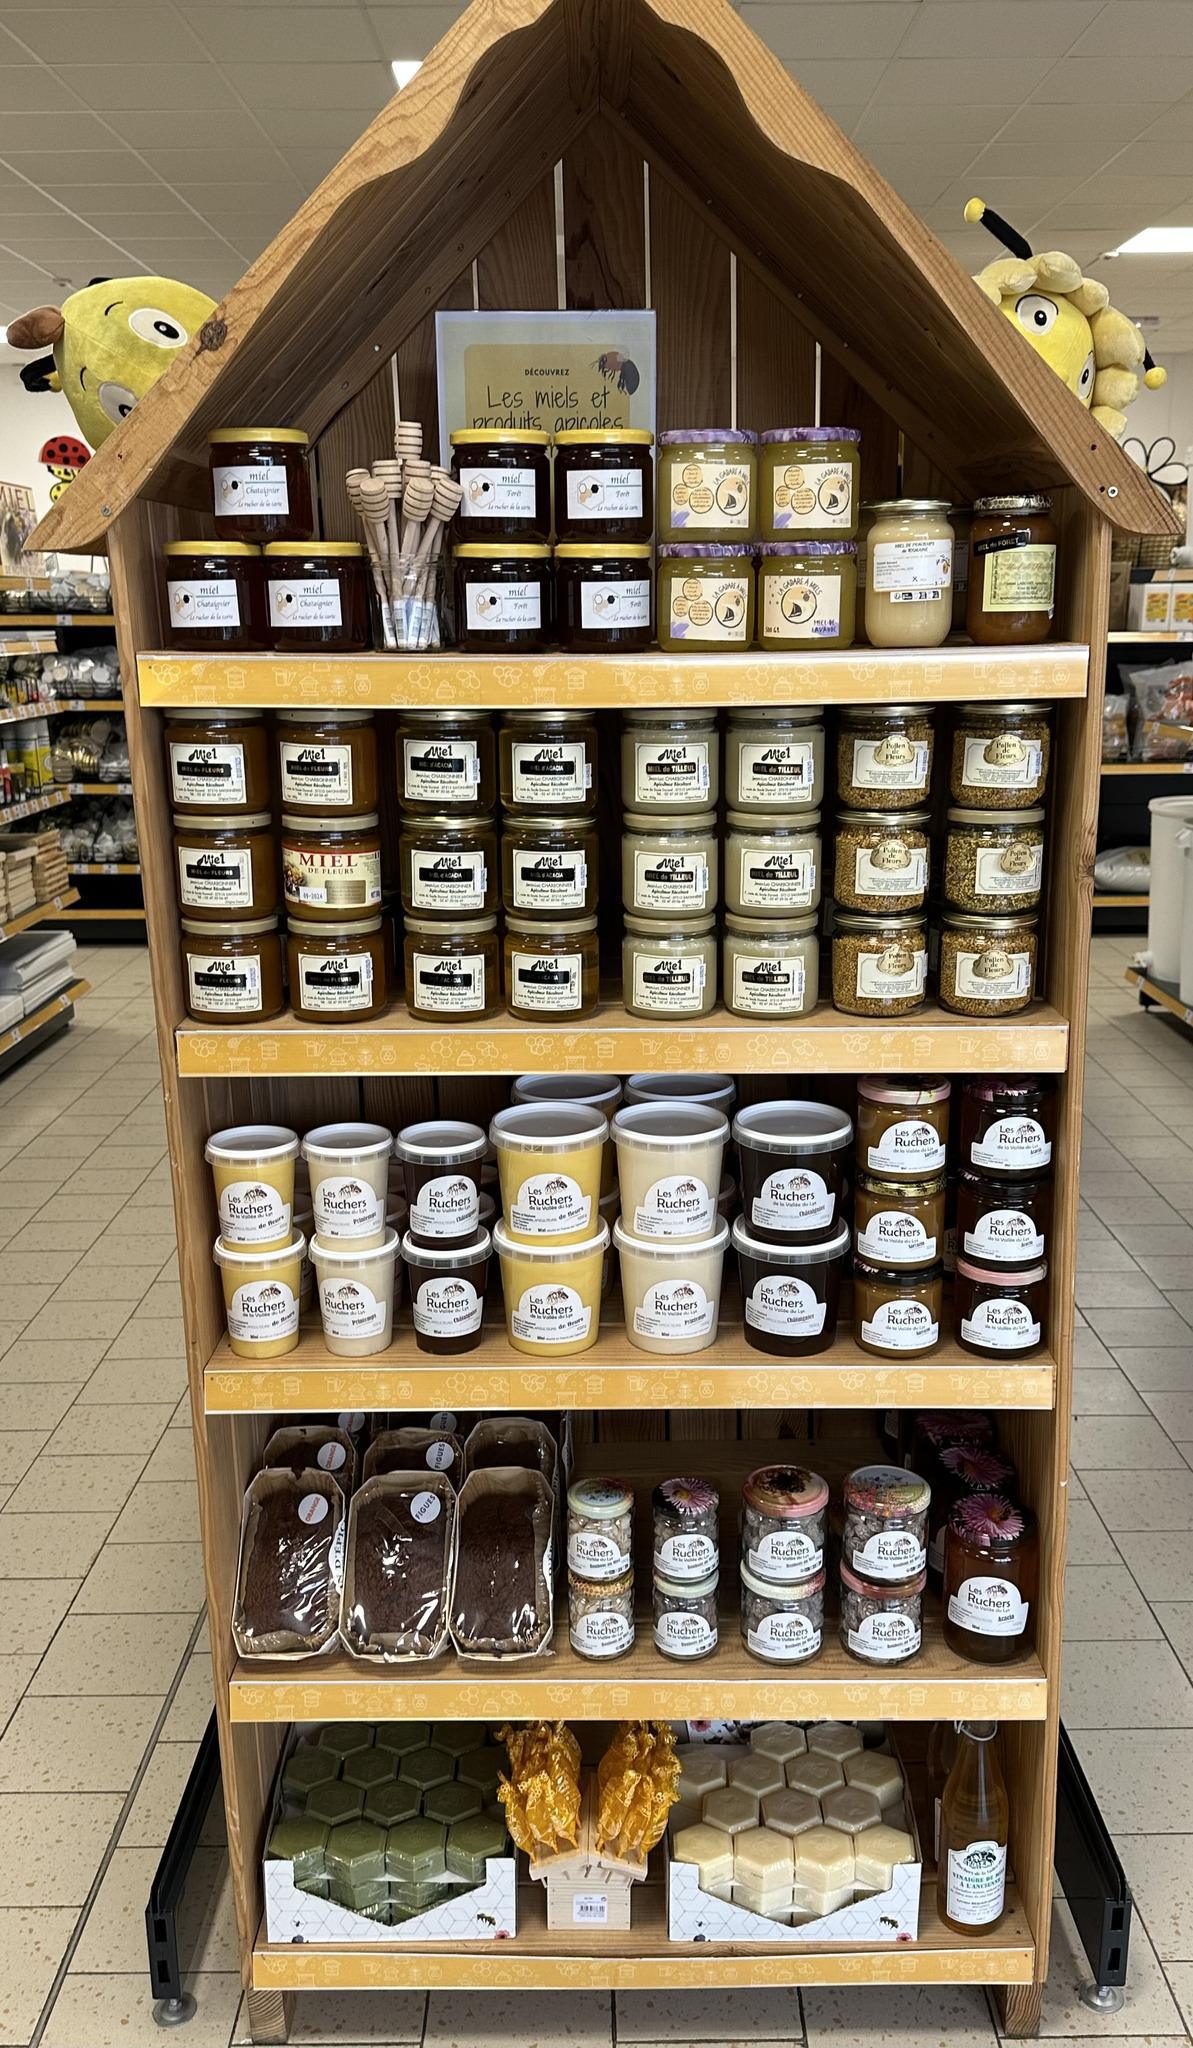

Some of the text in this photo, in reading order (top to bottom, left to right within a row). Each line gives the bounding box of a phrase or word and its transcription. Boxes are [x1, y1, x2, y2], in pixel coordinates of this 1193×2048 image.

[525, 367, 569, 376] DÉCOUVREZ
[487, 386, 610, 408] Les miels et
[250, 468, 270, 481] miel
[502, 473, 522, 484] miel
[611, 473, 631, 484] miel
[200, 585, 219, 594] miel
[303, 584, 323, 594] miel
[509, 585, 528, 596] miel
[626, 584, 642, 594] miel
[886, 742, 906, 750] Pollen
[996, 741, 1016, 750] Pollen
[189, 748, 217, 763] Miel
[298, 748, 326, 762] Miel
[424, 745, 452, 759] Miel
[534, 747, 563, 762] Miel
[658, 747, 686, 762] Miel
[761, 747, 790, 762] Miel
[882, 846, 902, 854] Pollen
[197, 853, 225, 867] Miel
[300, 854, 358, 867] MIEL
[433, 856, 461, 870] Miel
[534, 855, 562, 870] Miel
[656, 856, 685, 872] Miel
[764, 854, 793, 869] Miel
[207, 960, 235, 975] Miel
[320, 958, 348, 973] Miel
[434, 960, 462, 974] Miel
[531, 959, 558, 972] Miel
[654, 960, 682, 974] Miel
[754, 961, 782, 975] Miel
[895, 1129, 909, 1137] Les
[1000, 1125, 1014, 1133] Les
[895, 1137, 935, 1147] Ruchers
[1000, 1134, 1041, 1144] Ruchers
[771, 1180, 785, 1189] Les
[323, 1189, 335, 1198] Les
[429, 1188, 443, 1197] Les
[528, 1186, 542, 1195] Les
[657, 1189, 671, 1198] Les
[771, 1189, 815, 1201] Ruchers
[228, 1195, 241, 1203] Les
[323, 1198, 366, 1209] Ruchers
[429, 1197, 471, 1208] Ruchers
[529, 1195, 573, 1206] Ruchers
[657, 1197, 700, 1209] Ruchers
[229, 1203, 273, 1214] Ruchers
[568, 1207, 584, 1217] fleurs
[879, 1217, 892, 1226] Les
[990, 1217, 1004, 1226] Les
[879, 1226, 920, 1237] Ruchers
[990, 1226, 1031, 1236] Ruchers
[324, 1288, 335, 1299] Les
[426, 1289, 440, 1298] Les
[761, 1284, 774, 1294] Les
[241, 1294, 255, 1303] Les
[529, 1295, 543, 1304] Les
[655, 1292, 669, 1301] Les
[760, 1293, 804, 1308] Ruchers
[242, 1301, 286, 1313] Ruchers
[325, 1298, 365, 1310] Ruchers
[426, 1298, 469, 1309] Ruchers
[655, 1300, 698, 1311] Ruchers
[530, 1304, 573, 1315] Ruchers
[888, 1306, 901, 1315] Les
[987, 1305, 1001, 1314] Les
[887, 1315, 927, 1325] Ruchers
[986, 1314, 1027, 1324] Ruchers
[434, 1443, 445, 1469] FIGUES
[305, 1496, 321, 1523] ORANGE
[415, 1495, 436, 1520] FIGUES
[576, 1536, 587, 1546] Les
[673, 1540, 685, 1548] Les
[771, 1538, 784, 1546] Les
[878, 1538, 892, 1546] Les
[576, 1545, 613, 1557] Ruchers
[672, 1548, 710, 1558] Ruchers
[771, 1546, 809, 1556] Ruchers
[878, 1546, 915, 1556] Ruchers
[968, 1584, 982, 1595] Les
[968, 1593, 1011, 1608] Ruchers
[586, 1618, 599, 1626] Les
[667, 1617, 678, 1625] Les
[998, 1614, 1015, 1623] Acacia
[770, 1620, 784, 1628] Les
[873, 1620, 885, 1628] Les
[586, 1625, 623, 1635] Ruchers
[667, 1624, 704, 1635] Ruchers
[770, 1627, 808, 1637] Ruchers
[872, 1627, 910, 1636] Ruchers
